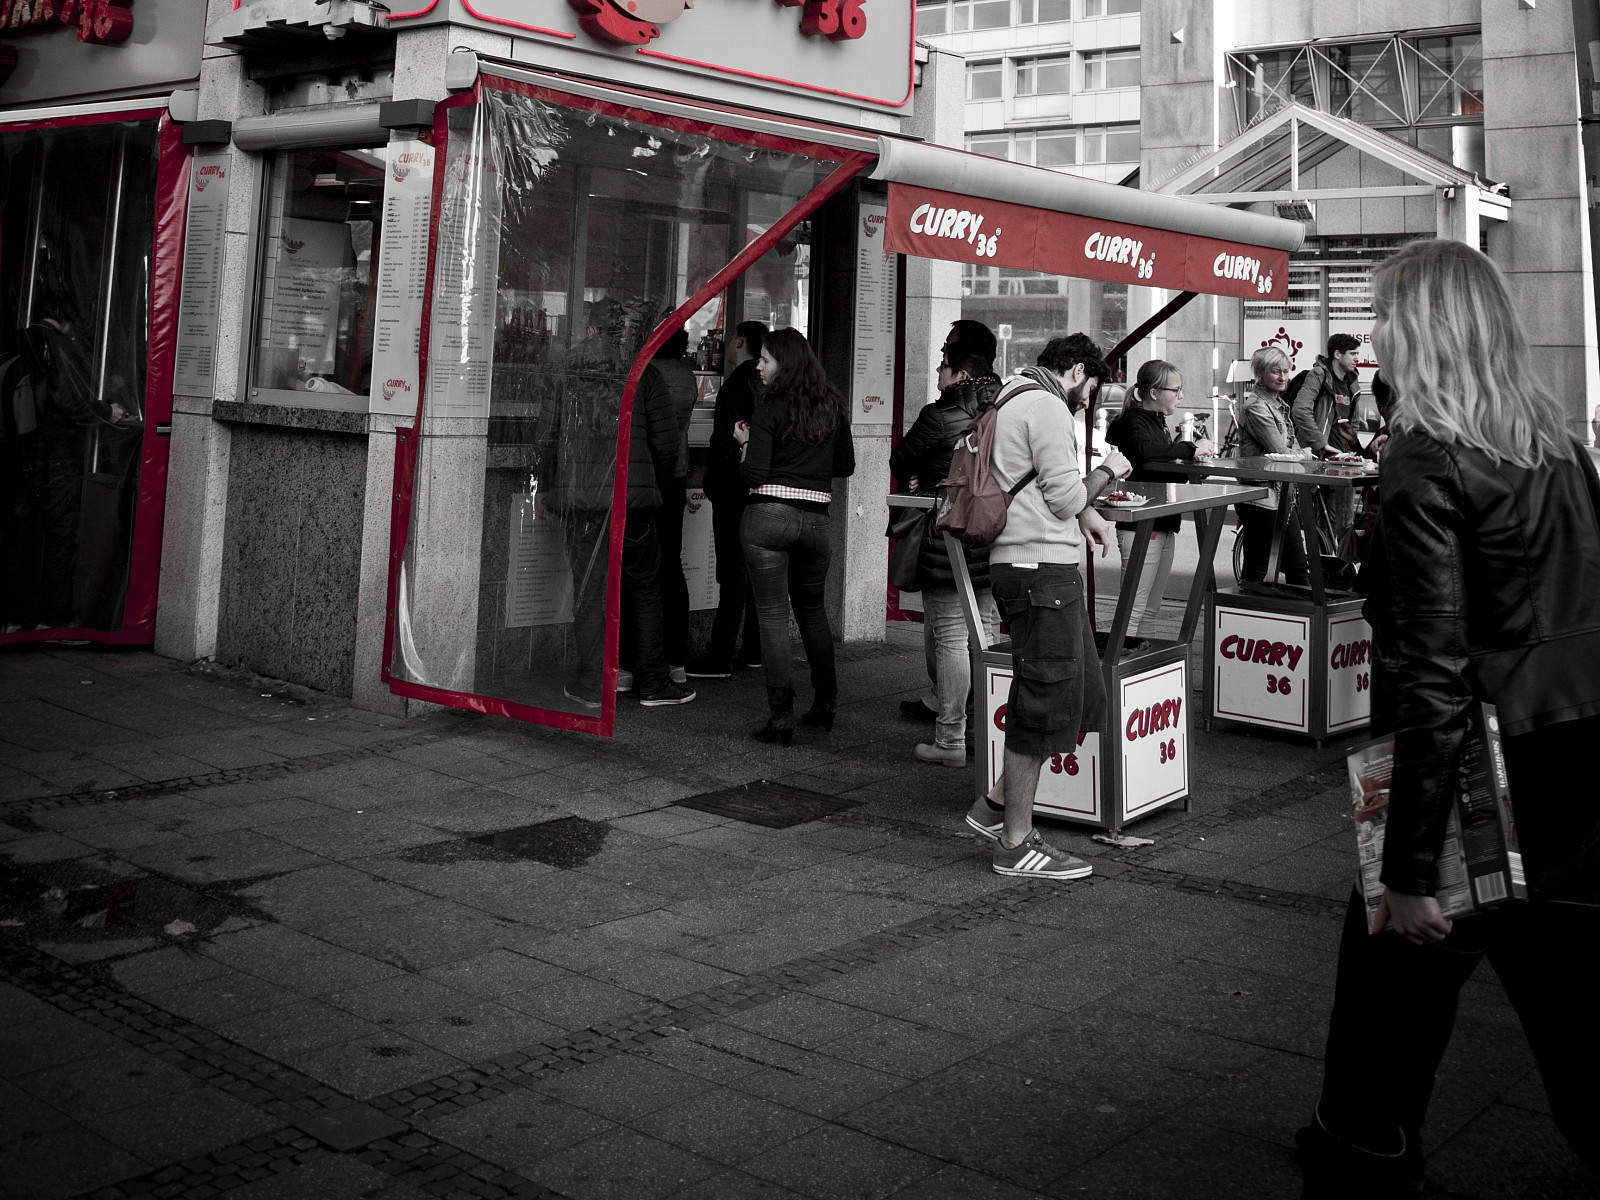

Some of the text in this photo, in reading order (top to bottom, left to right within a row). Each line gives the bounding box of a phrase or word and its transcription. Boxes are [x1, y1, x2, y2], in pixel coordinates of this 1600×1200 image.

[200, 166, 221, 176] CURRY
[397, 152, 425, 164] CURRY
[909, 203, 998, 258] CURRY 36
[1084, 231, 1153, 279] CURRY 36
[1213, 252, 1272, 294] CURRY 36
[386, 379, 406, 389] CURRY
[1220, 635, 1304, 671] CURRY
[1330, 639, 1373, 670] CURRY
[1266, 674, 1292, 695] 36
[1356, 672, 1369, 692] 36
[1126, 697, 1182, 742] CURRY
[1160, 738, 1176, 764] 36
[1050, 753, 1079, 776] 36
